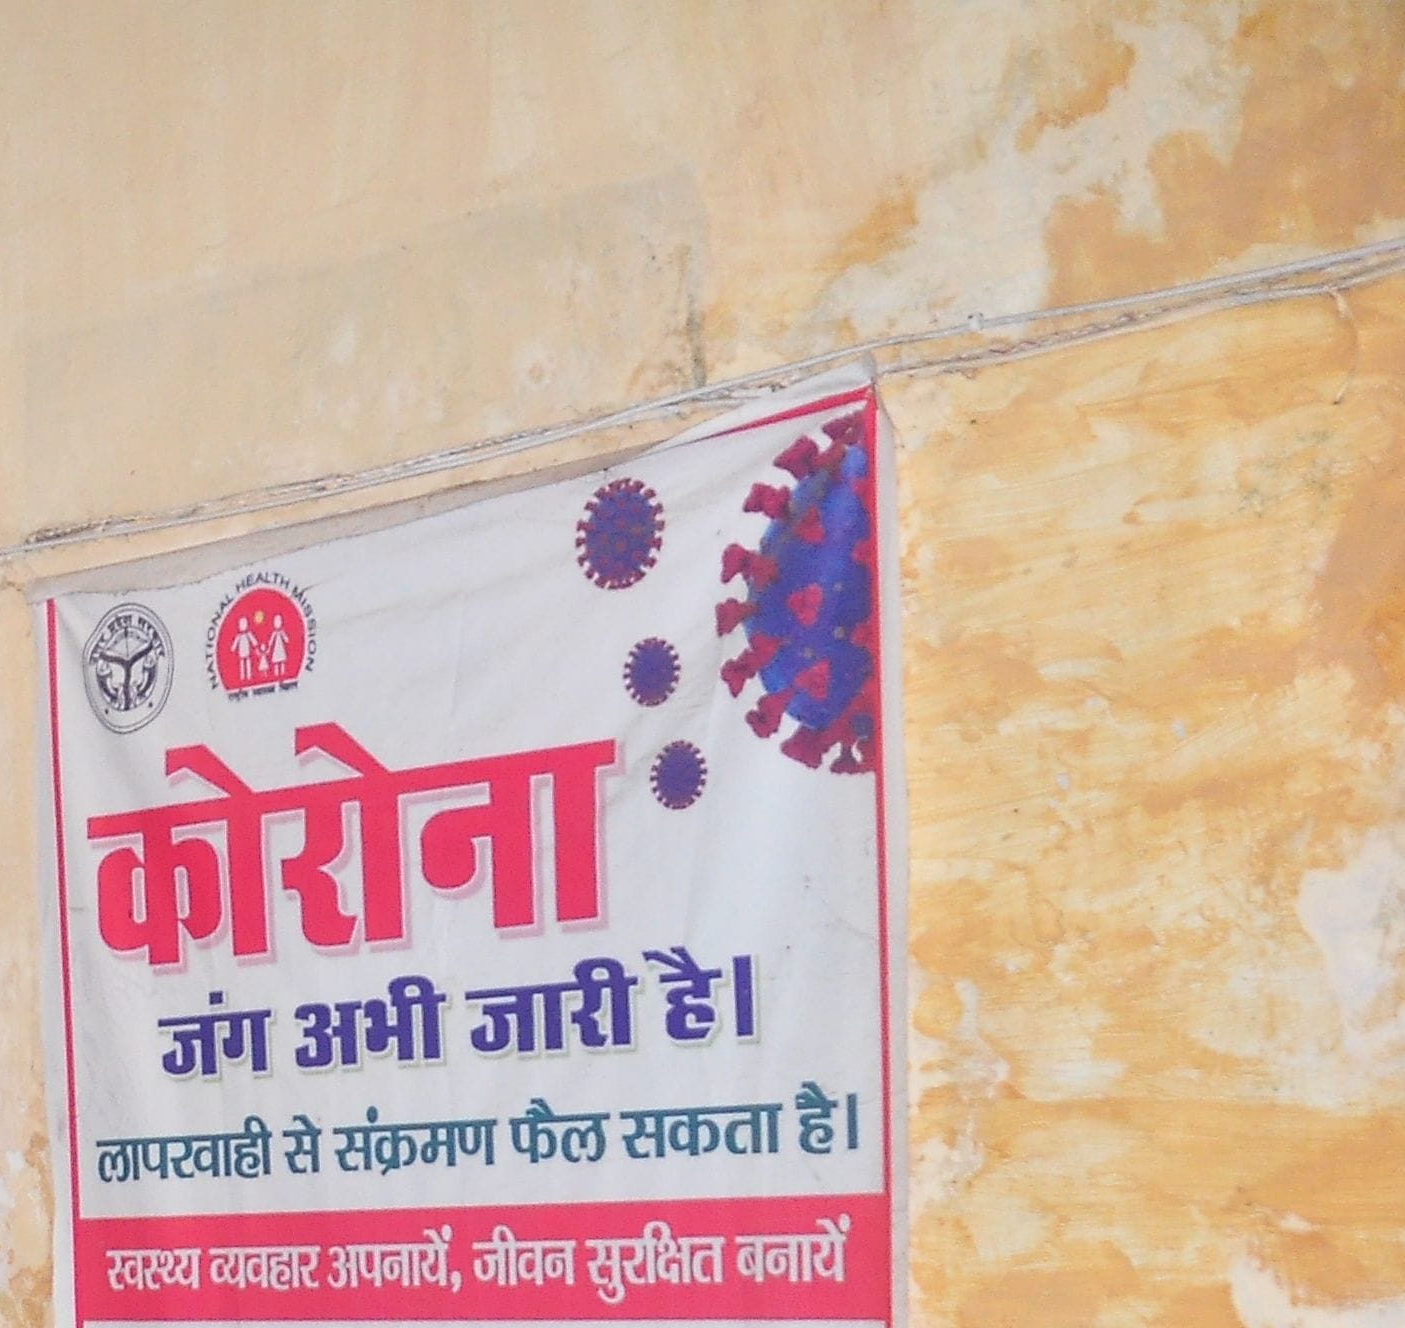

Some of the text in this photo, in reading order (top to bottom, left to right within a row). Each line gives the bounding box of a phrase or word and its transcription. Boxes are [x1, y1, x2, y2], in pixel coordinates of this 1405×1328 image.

[206, 572, 318, 689] NATIONAL HEALTH MISSION
[87, 720, 623, 972] कोरोना
[159, 945, 756, 1077] जंग अभी जारी है।
[97, 1081, 859, 1183] लापरवाही से संक्रमण फैल सकता है।
[208, 1247, 320, 1292] व्यवहार
[328, 1230, 462, 1294] अपनायें,
[473, 1227, 575, 1286] जीवन
[589, 1219, 725, 1303] सुरक्षित
[736, 1214, 851, 1284] बनायें
